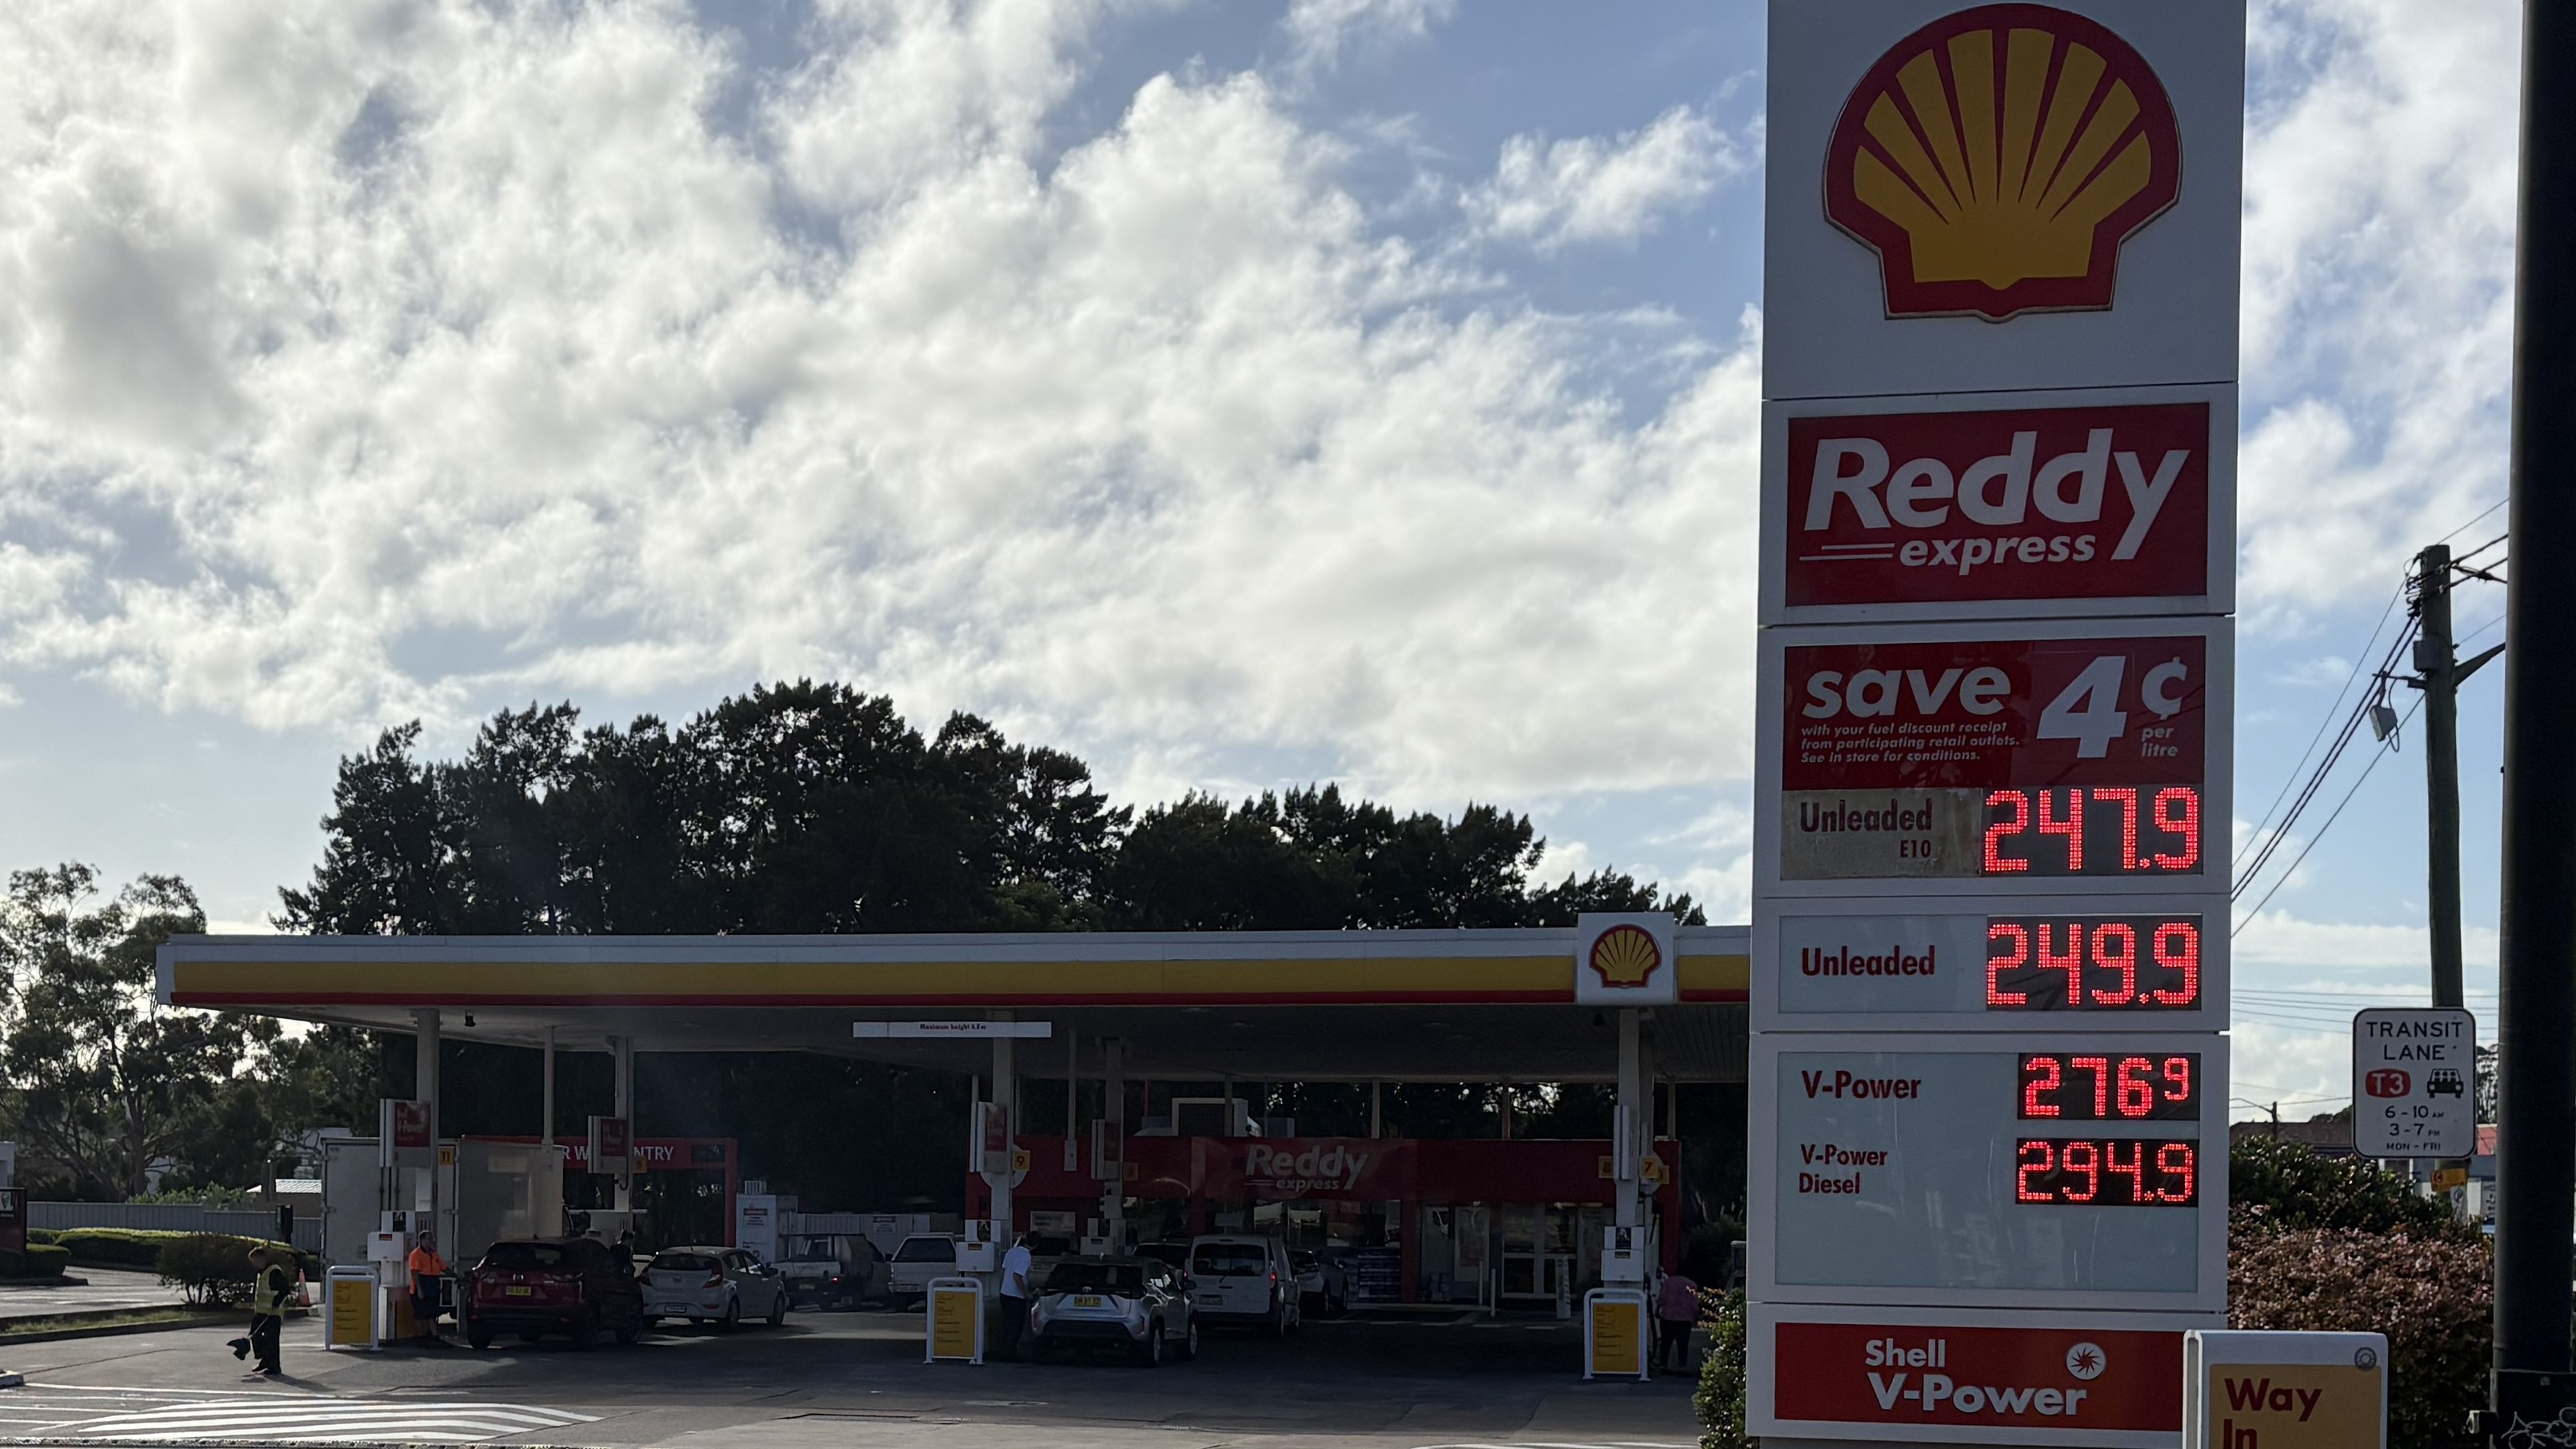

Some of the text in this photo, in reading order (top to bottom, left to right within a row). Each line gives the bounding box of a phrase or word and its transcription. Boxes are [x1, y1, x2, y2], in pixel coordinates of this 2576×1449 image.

[1804, 428, 2191, 560] Reddy
[1899, 533, 2096, 576] express
[1802, 666, 2011, 719] save
[1801, 721, 2007, 738] with your fuel discount receipt
[2141, 727, 2175, 742] per
[1801, 734, 2020, 751] from participating retail outlets.
[2141, 743, 2179, 757] litre
[1801, 749, 1980, 764] See in store for conditions.
[1800, 800, 1933, 832] Unleaded
[1984, 787, 2199, 872] 247.9
[1899, 840, 1932, 858] E10
[1801, 944, 1935, 976] Unleaded
[1987, 923, 2199, 1006] 249.9
[2366, 1021, 2463, 1038] TRANSIT
[2384, 1044, 2446, 1060] LANE
[1801, 1070, 1922, 1099] V-Power
[2371, 1072, 2406, 1095] T3
[633, 1146, 674, 1161] NTRY
[1016, 1156, 1025, 1166] 9
[1800, 1144, 1888, 1167] V-Power
[1245, 1144, 1369, 1190] Reddy
[1644, 1161, 1653, 1173] 7
[2019, 1141, 2194, 1201] 294.9
[1276, 1178, 1340, 1192] express
[1798, 1172, 1861, 1193] Diesel
[1865, 1338, 1946, 1367] Shell
[1867, 1372, 2087, 1415] V-Power
[2224, 1378, 2323, 1421] Way
[2223, 1418, 2258, 1449] In
